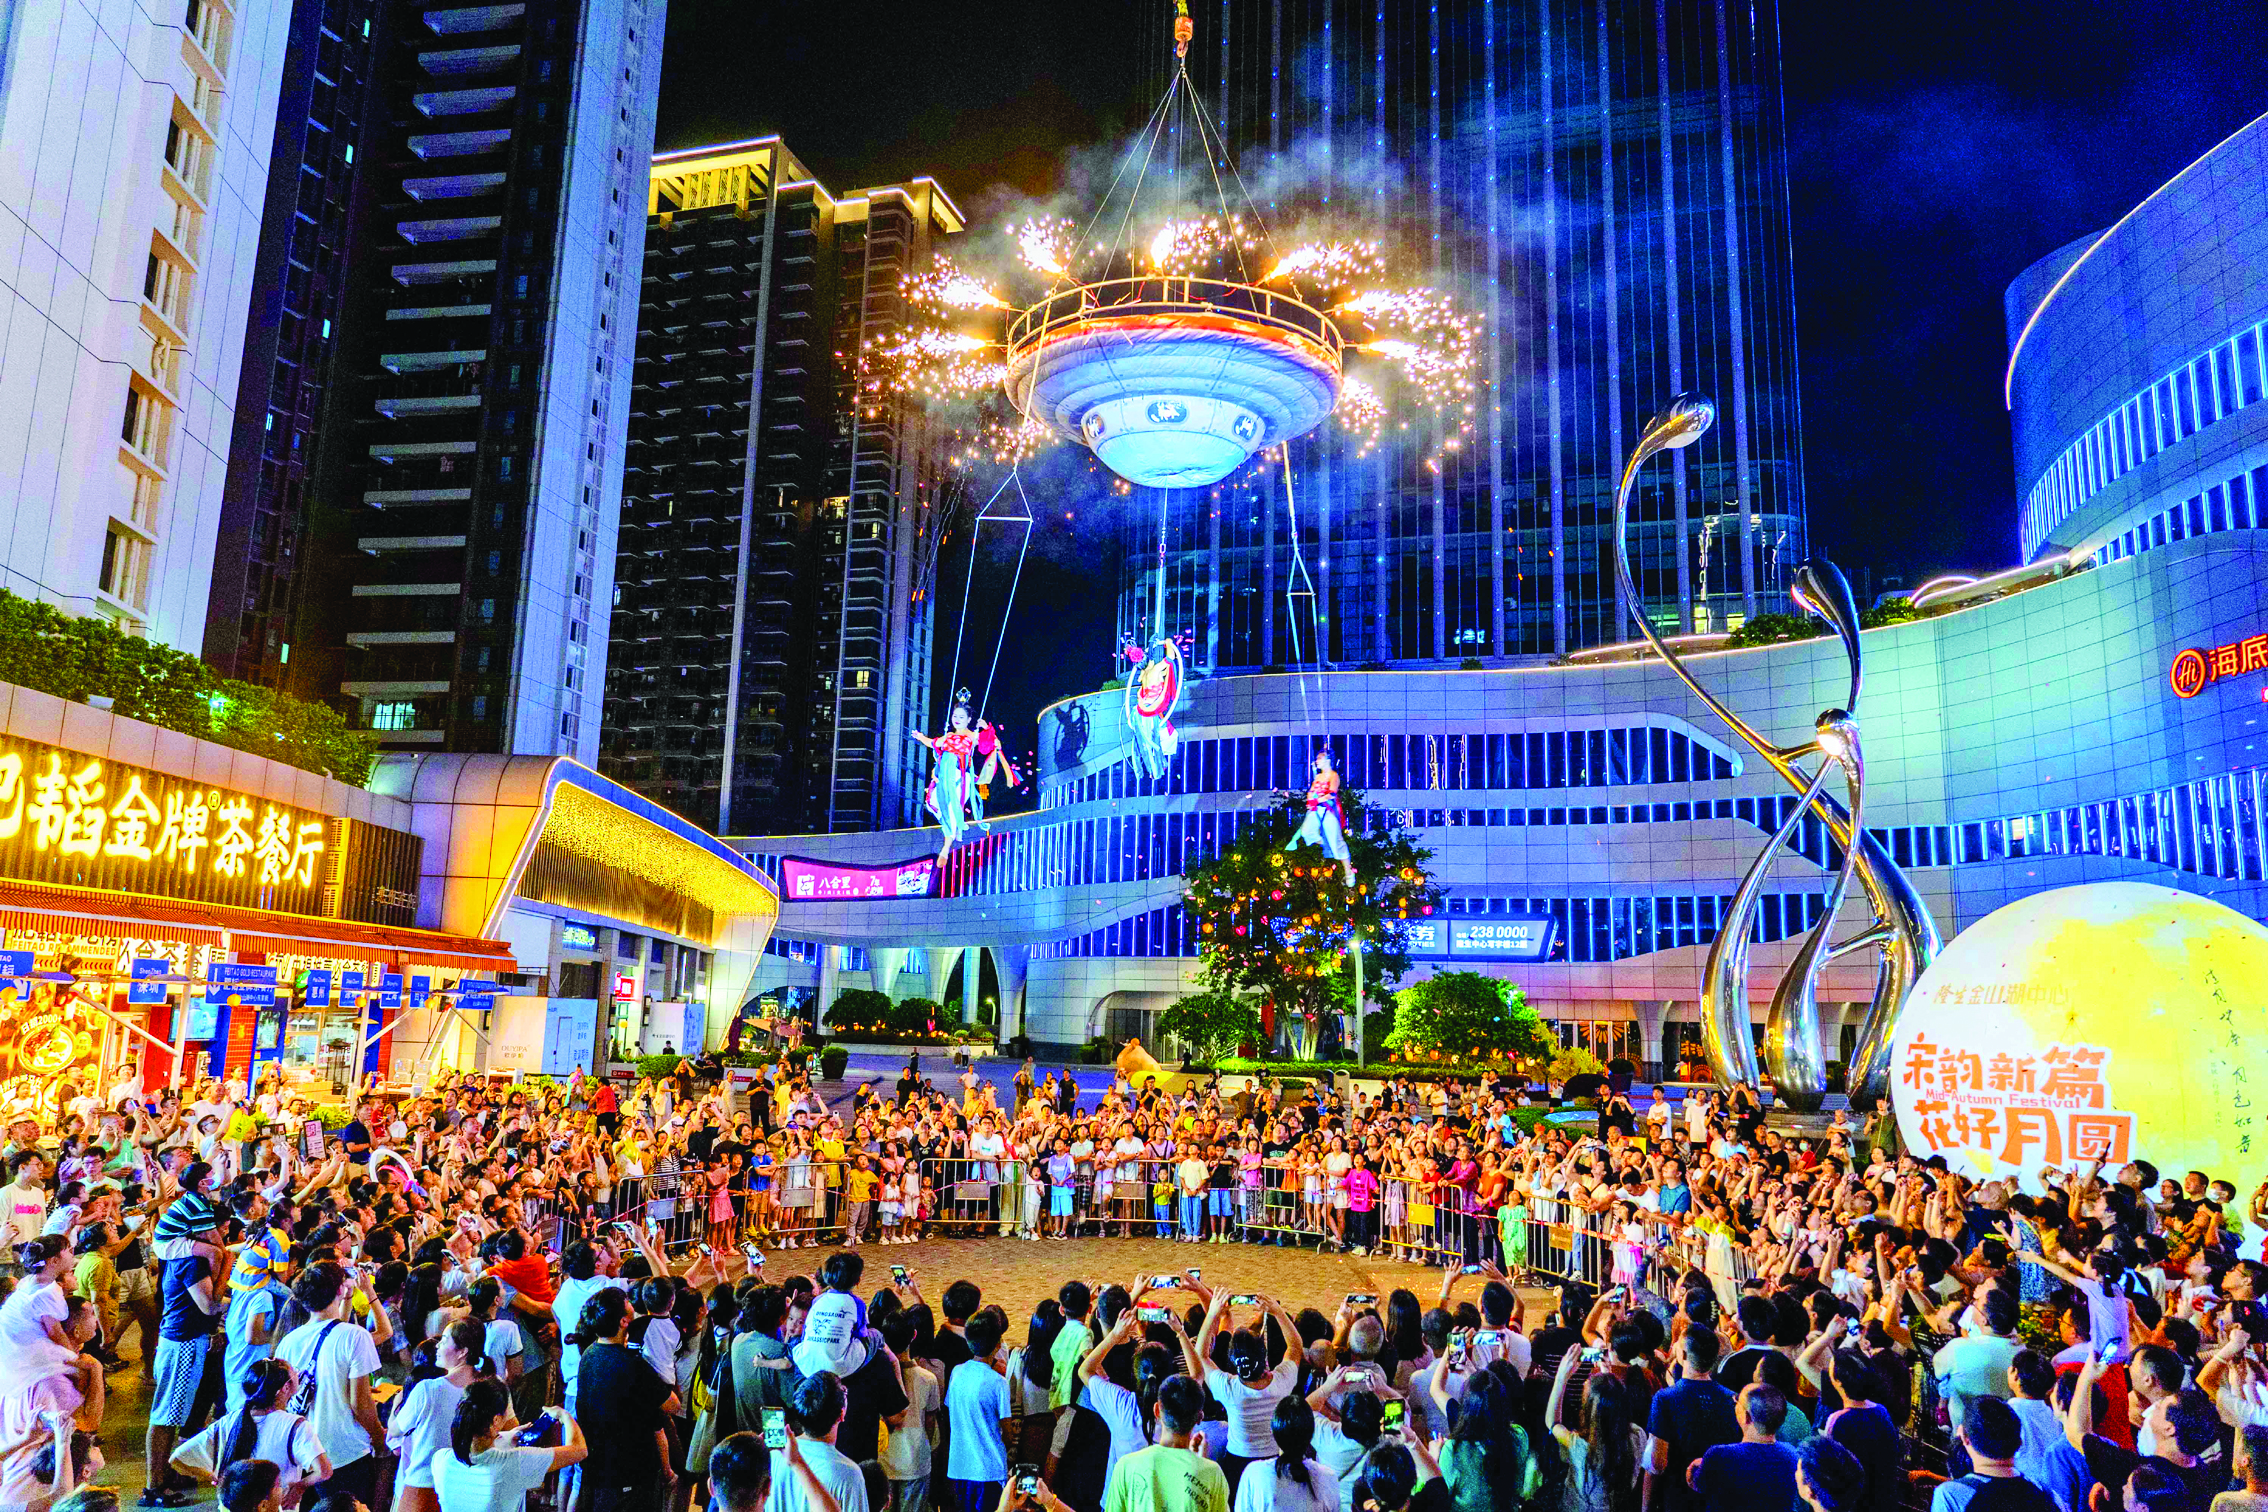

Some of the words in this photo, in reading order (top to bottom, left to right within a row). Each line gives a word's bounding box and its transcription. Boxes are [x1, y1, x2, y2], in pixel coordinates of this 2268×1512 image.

[2208, 633, 2268, 682] 海底
[819, 875, 851, 889] 八合里
[1470, 925, 1494, 938] 238
[1496, 925, 1528, 938] 0000
[1903, 1032, 2106, 1109] 宋韵新篇
[1926, 1088, 2003, 1105] Mid-Autumn
[2009, 1093, 2081, 1109] Festival
[1914, 1099, 2132, 1167] 花好月圆
